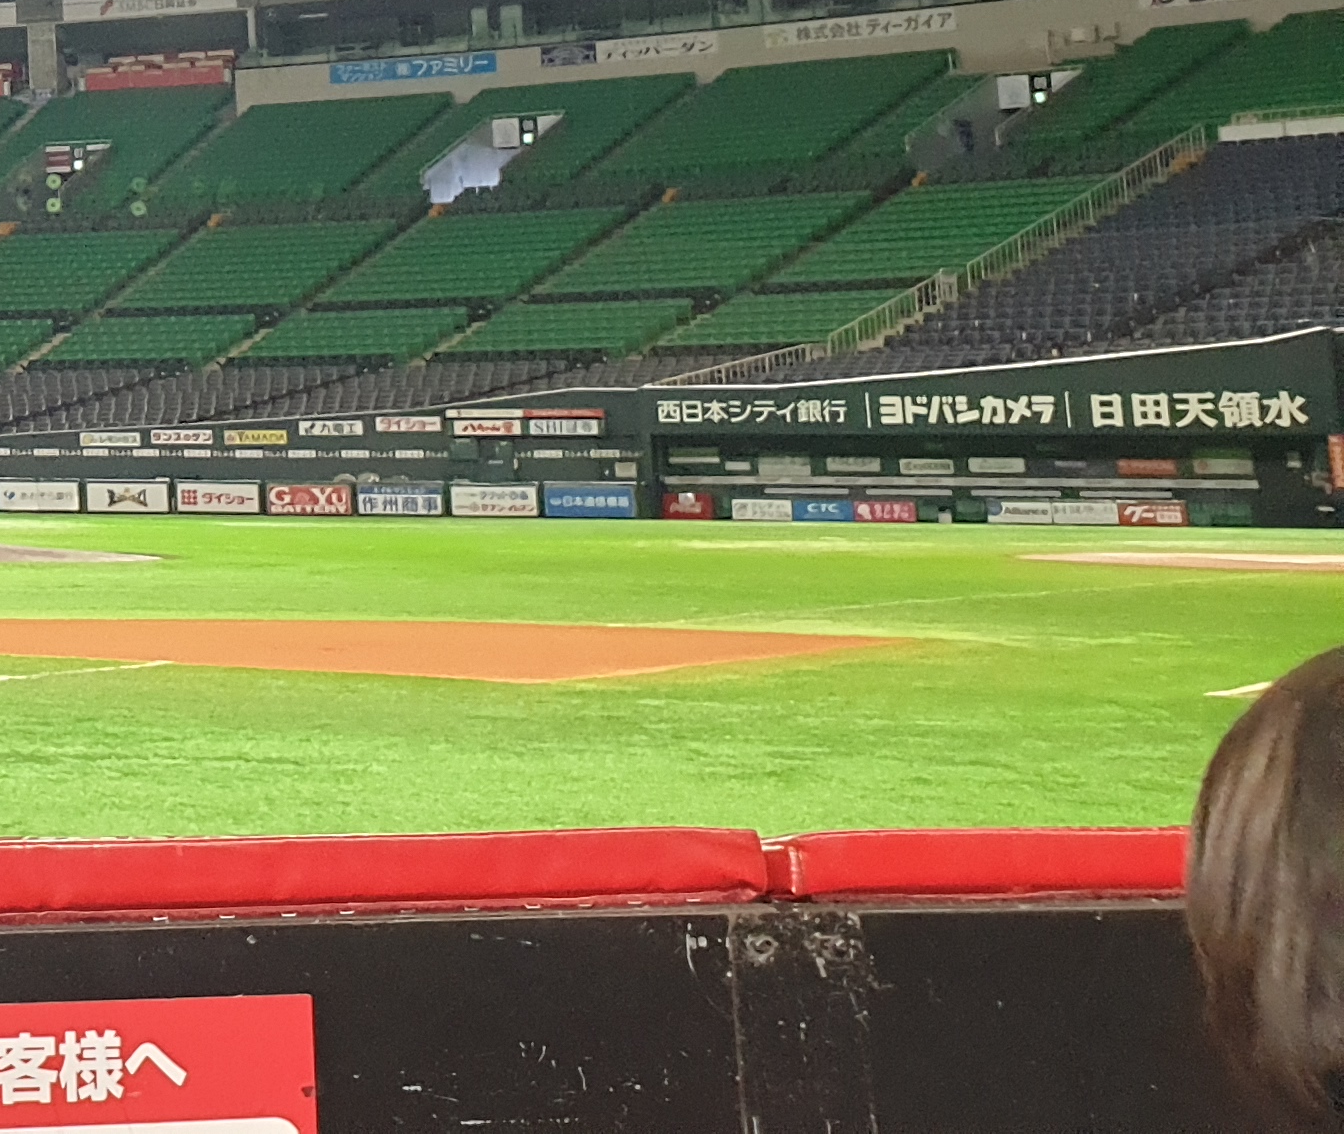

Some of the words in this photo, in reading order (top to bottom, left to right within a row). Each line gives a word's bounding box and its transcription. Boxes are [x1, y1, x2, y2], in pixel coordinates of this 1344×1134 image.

[656, 398, 847, 424] 西日本シティ銀行
[878, 394, 1056, 425] ヨドバシカメラ
[1089, 390, 1310, 428] 日田天領水
[201, 491, 255, 506] ダイショー
